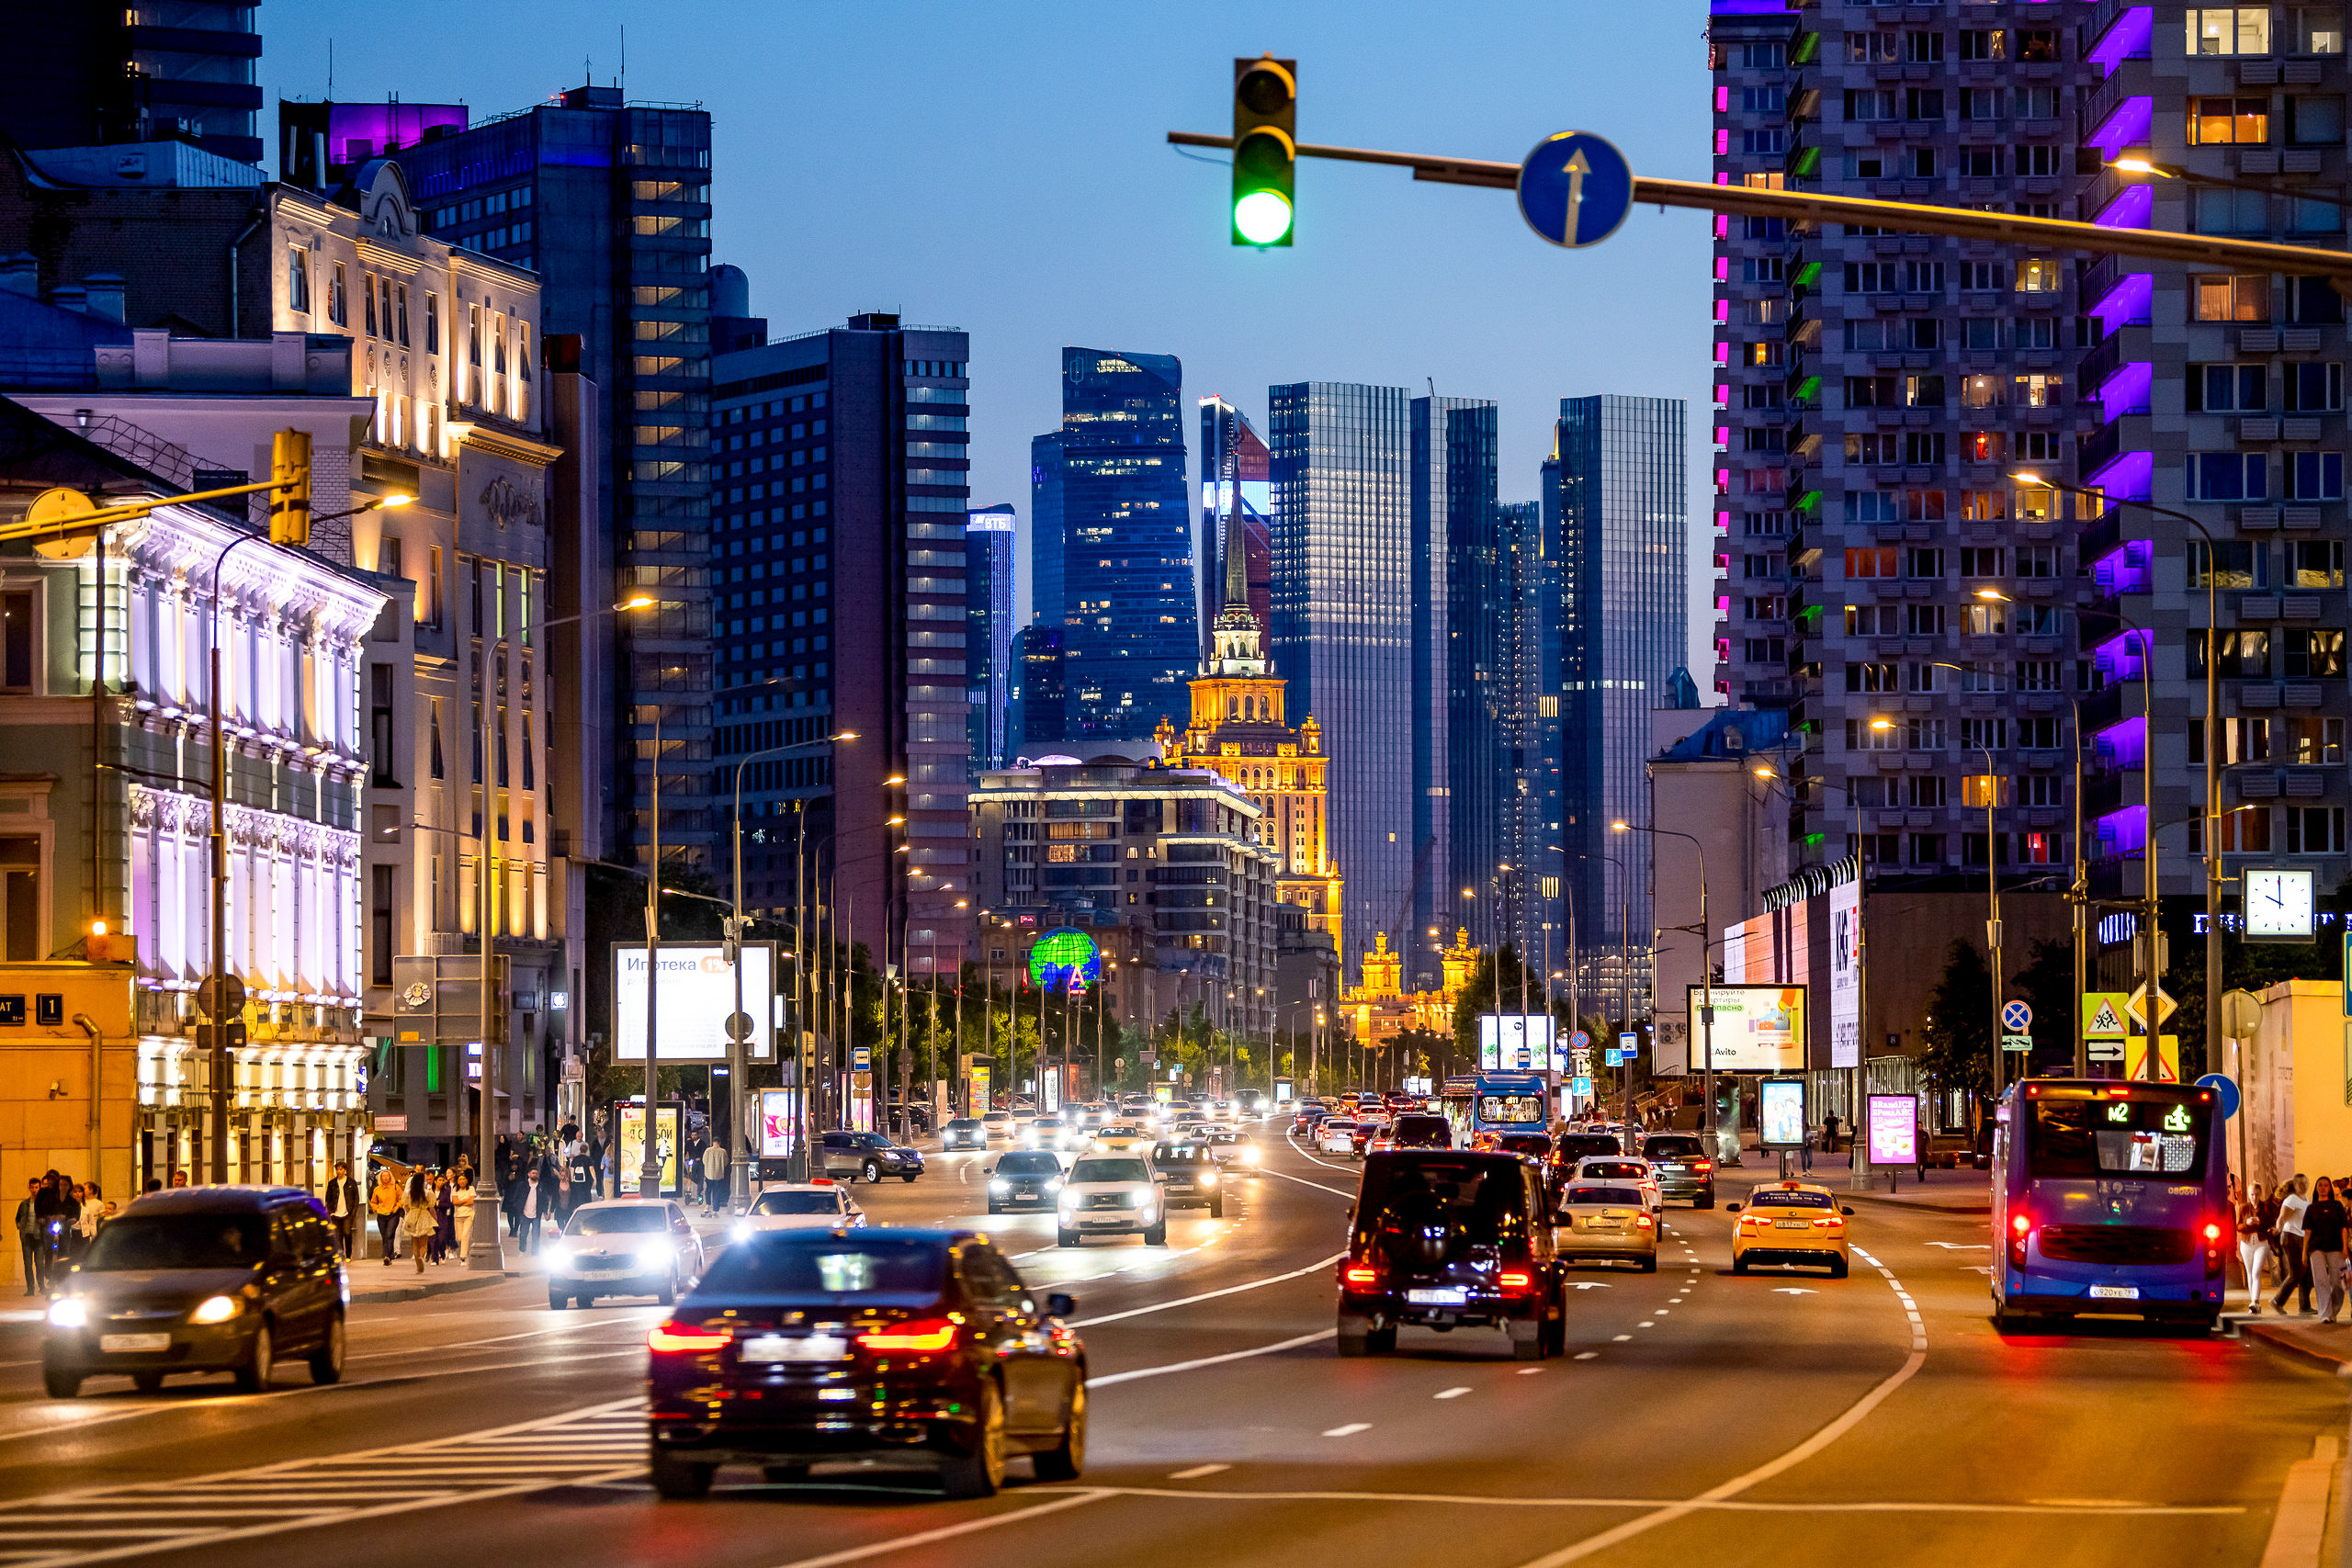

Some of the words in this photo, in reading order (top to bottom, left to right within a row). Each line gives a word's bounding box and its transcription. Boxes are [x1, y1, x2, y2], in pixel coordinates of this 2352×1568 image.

[985, 517, 1007, 529] ВТБ
[49, 999, 54, 1014] 1
[1714, 1048, 1736, 1056] Avito
